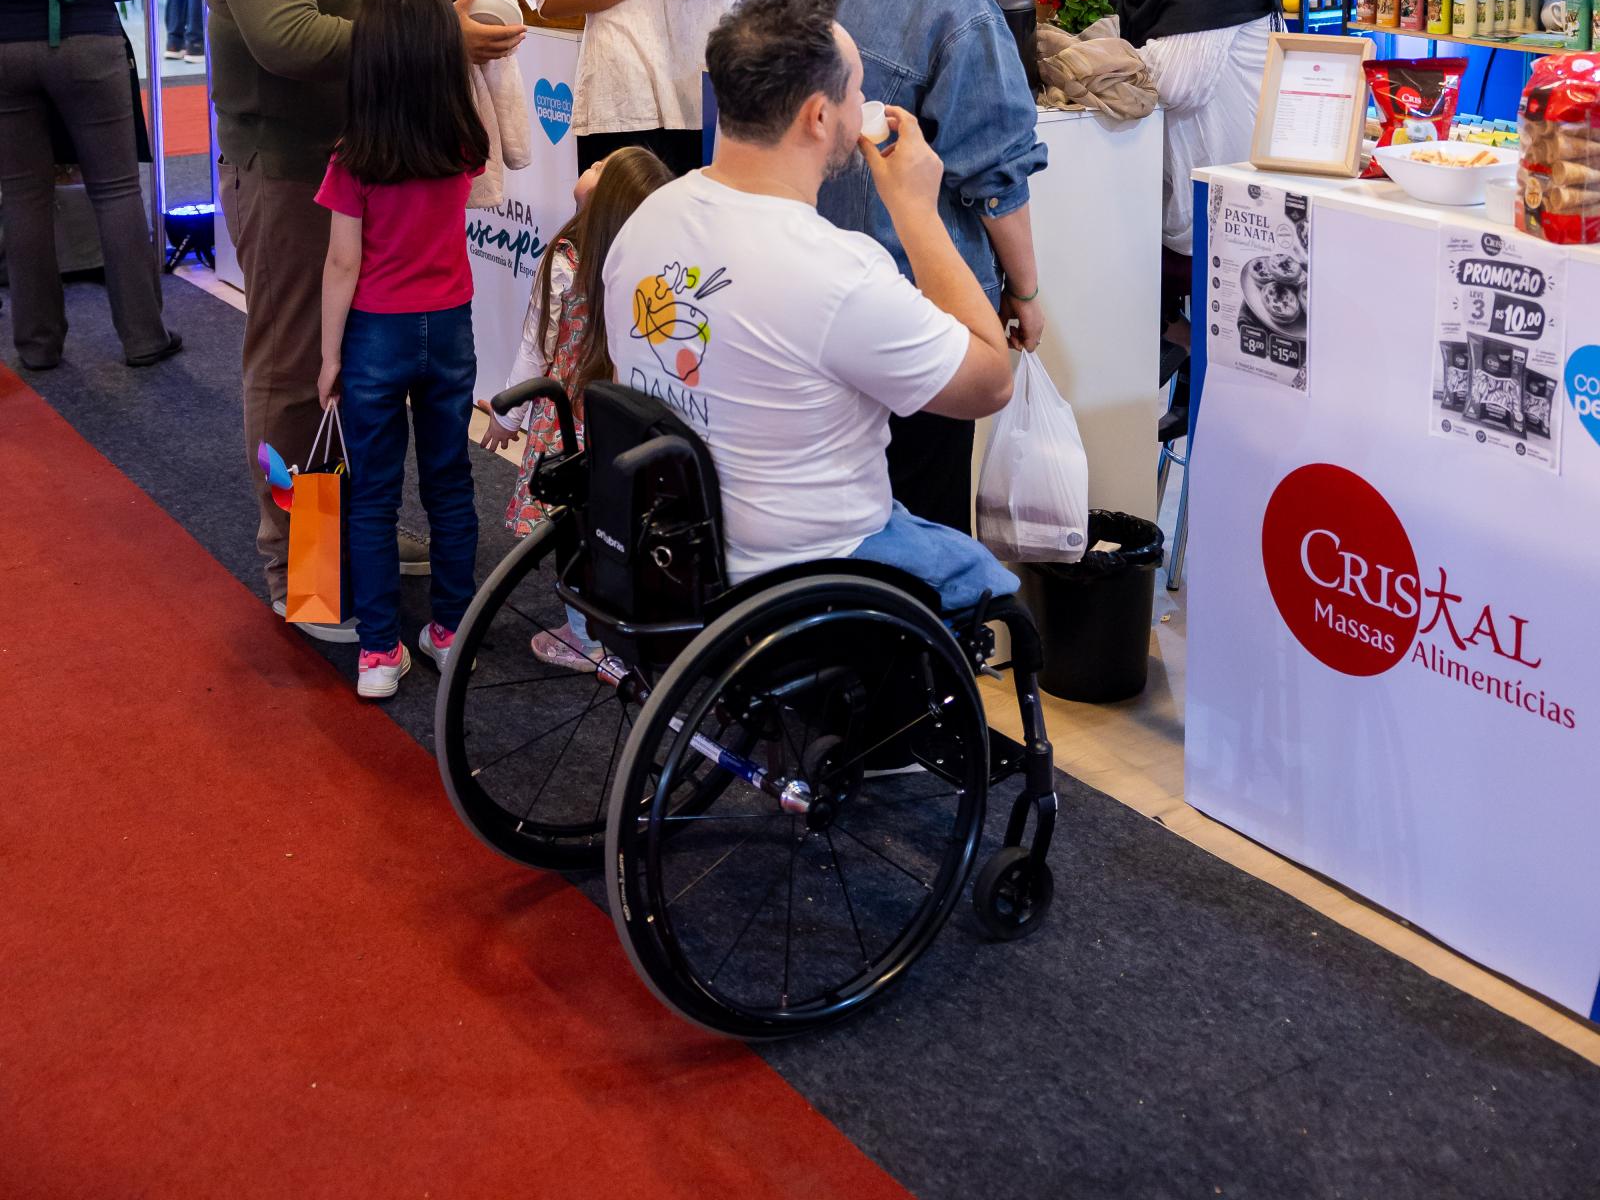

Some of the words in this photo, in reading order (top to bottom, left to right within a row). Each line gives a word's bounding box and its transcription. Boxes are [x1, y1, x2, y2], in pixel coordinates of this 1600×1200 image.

[483, 198, 533, 227] CARA
[1224, 208, 1270, 228] PASTEL
[1224, 222, 1240, 235] DE
[1244, 226, 1276, 244] NATA
[469, 243, 507, 267] Gastronomia
[519, 262, 537, 278] Espor
[1462, 262, 1541, 294] PROMOÇÃO
[1471, 299, 1486, 320] 3
[1300, 529, 1542, 669] CRISTAL
[1314, 597, 1396, 654] Massas
[1411, 640, 1576, 729] Alimentícias
